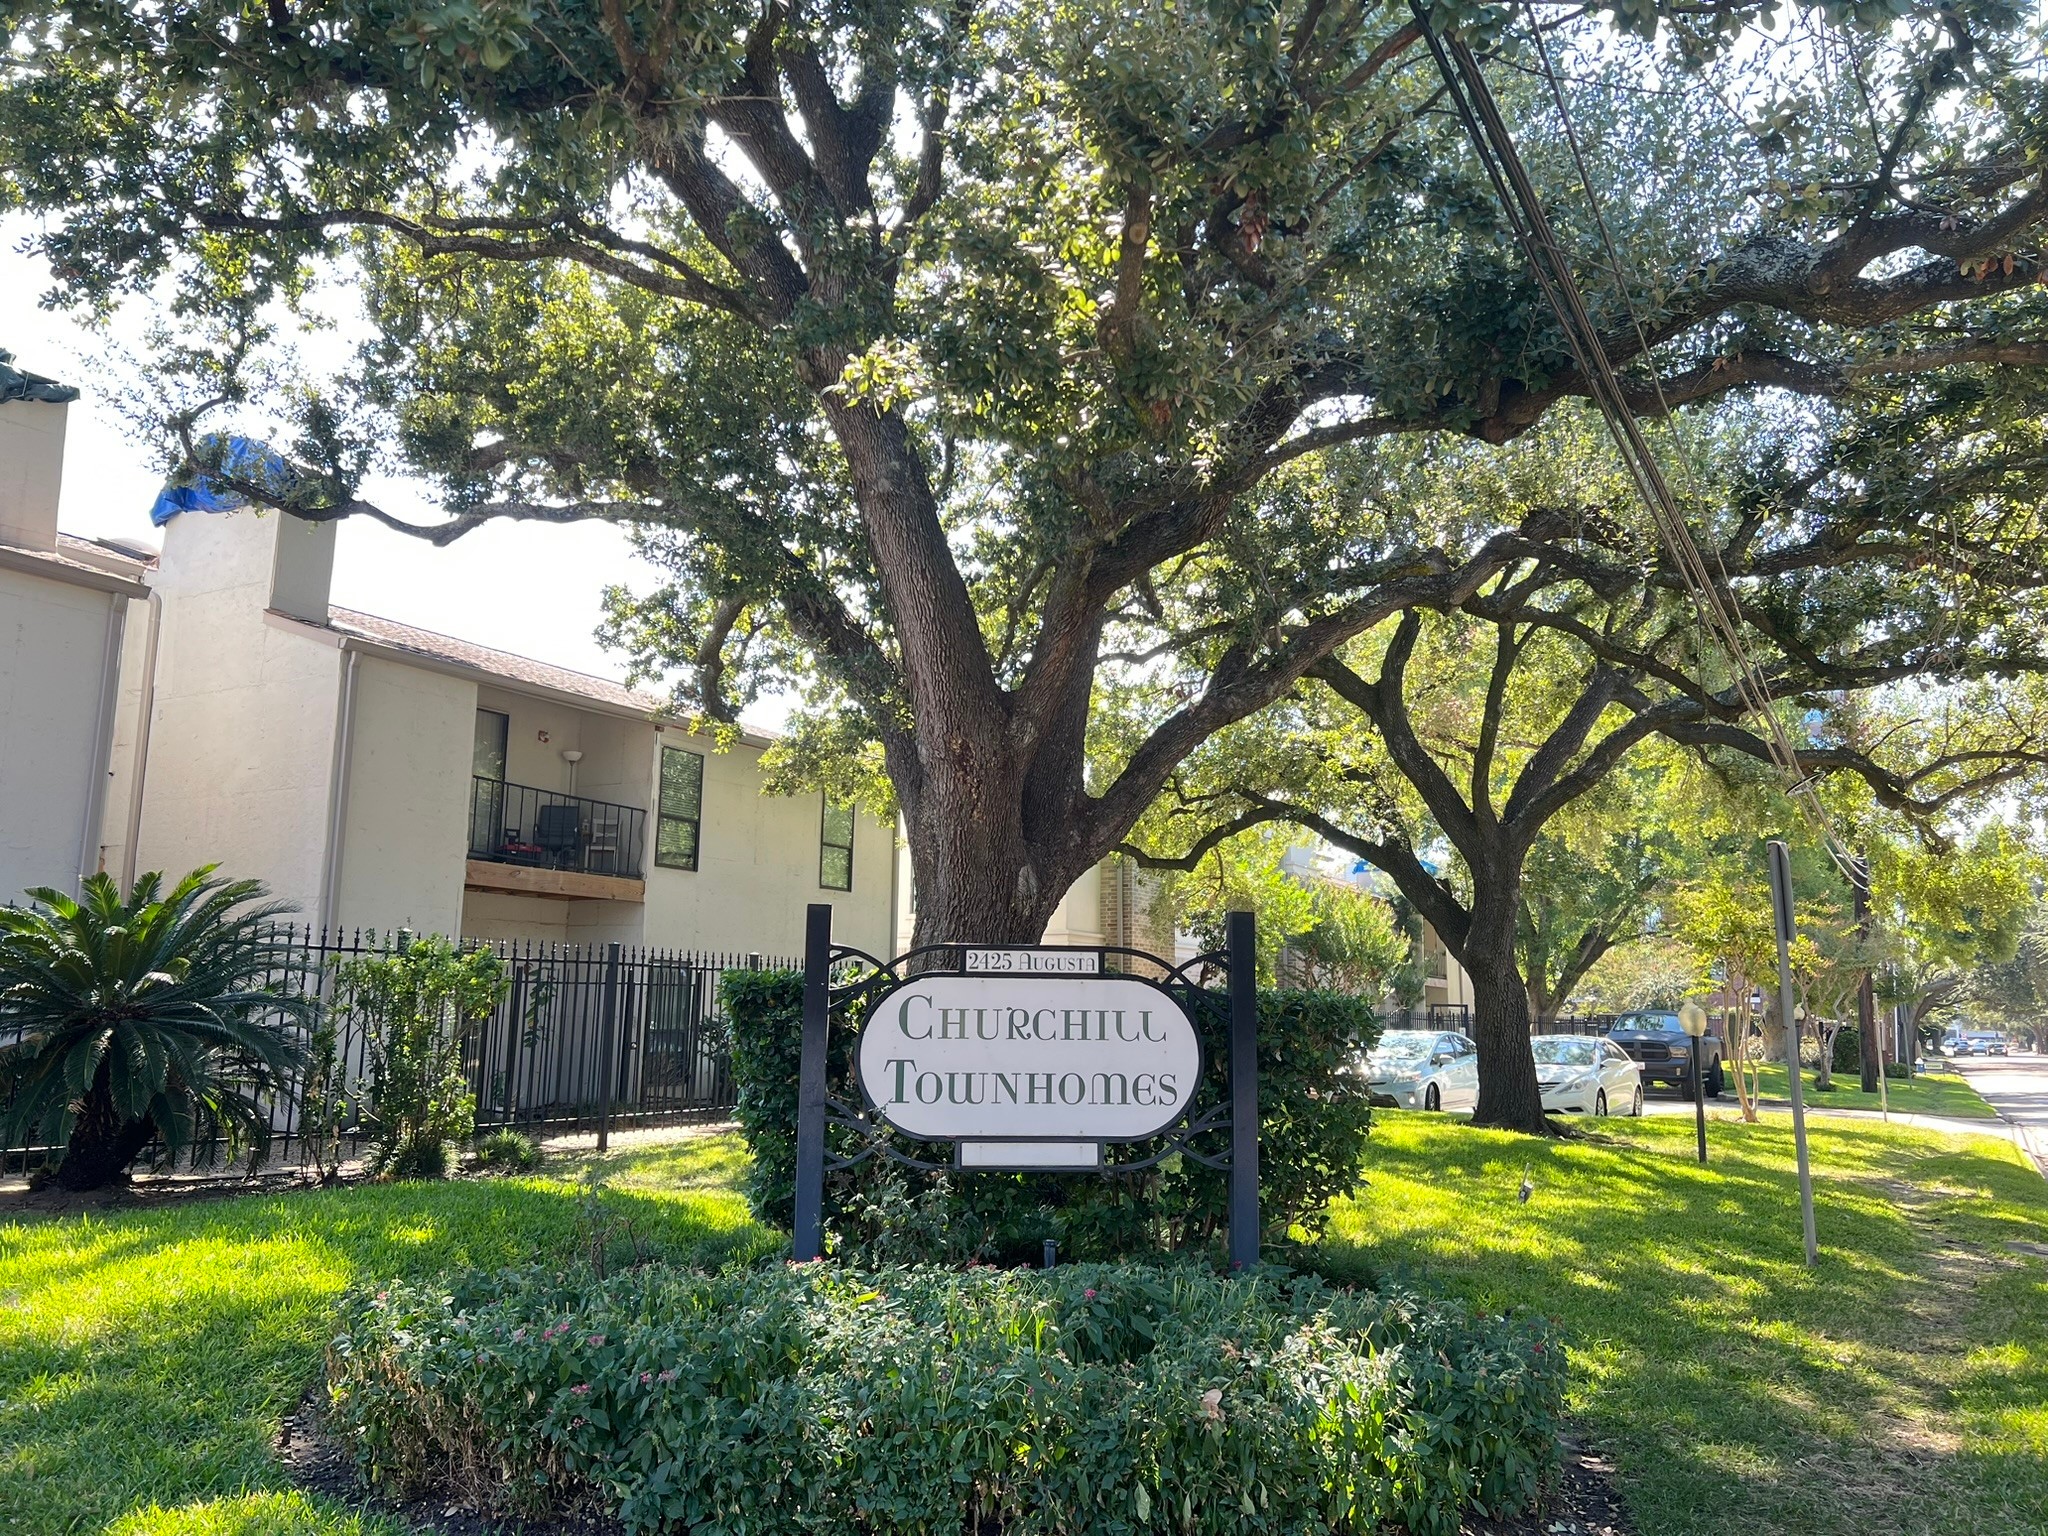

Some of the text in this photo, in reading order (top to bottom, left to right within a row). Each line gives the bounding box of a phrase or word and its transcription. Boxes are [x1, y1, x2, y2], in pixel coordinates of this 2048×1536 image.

[968, 952, 1096, 972] 2425 AUGUSTA
[898, 994, 1168, 1043] CHURCHILL
[884, 1058, 1178, 1106] TOWNHOMES
